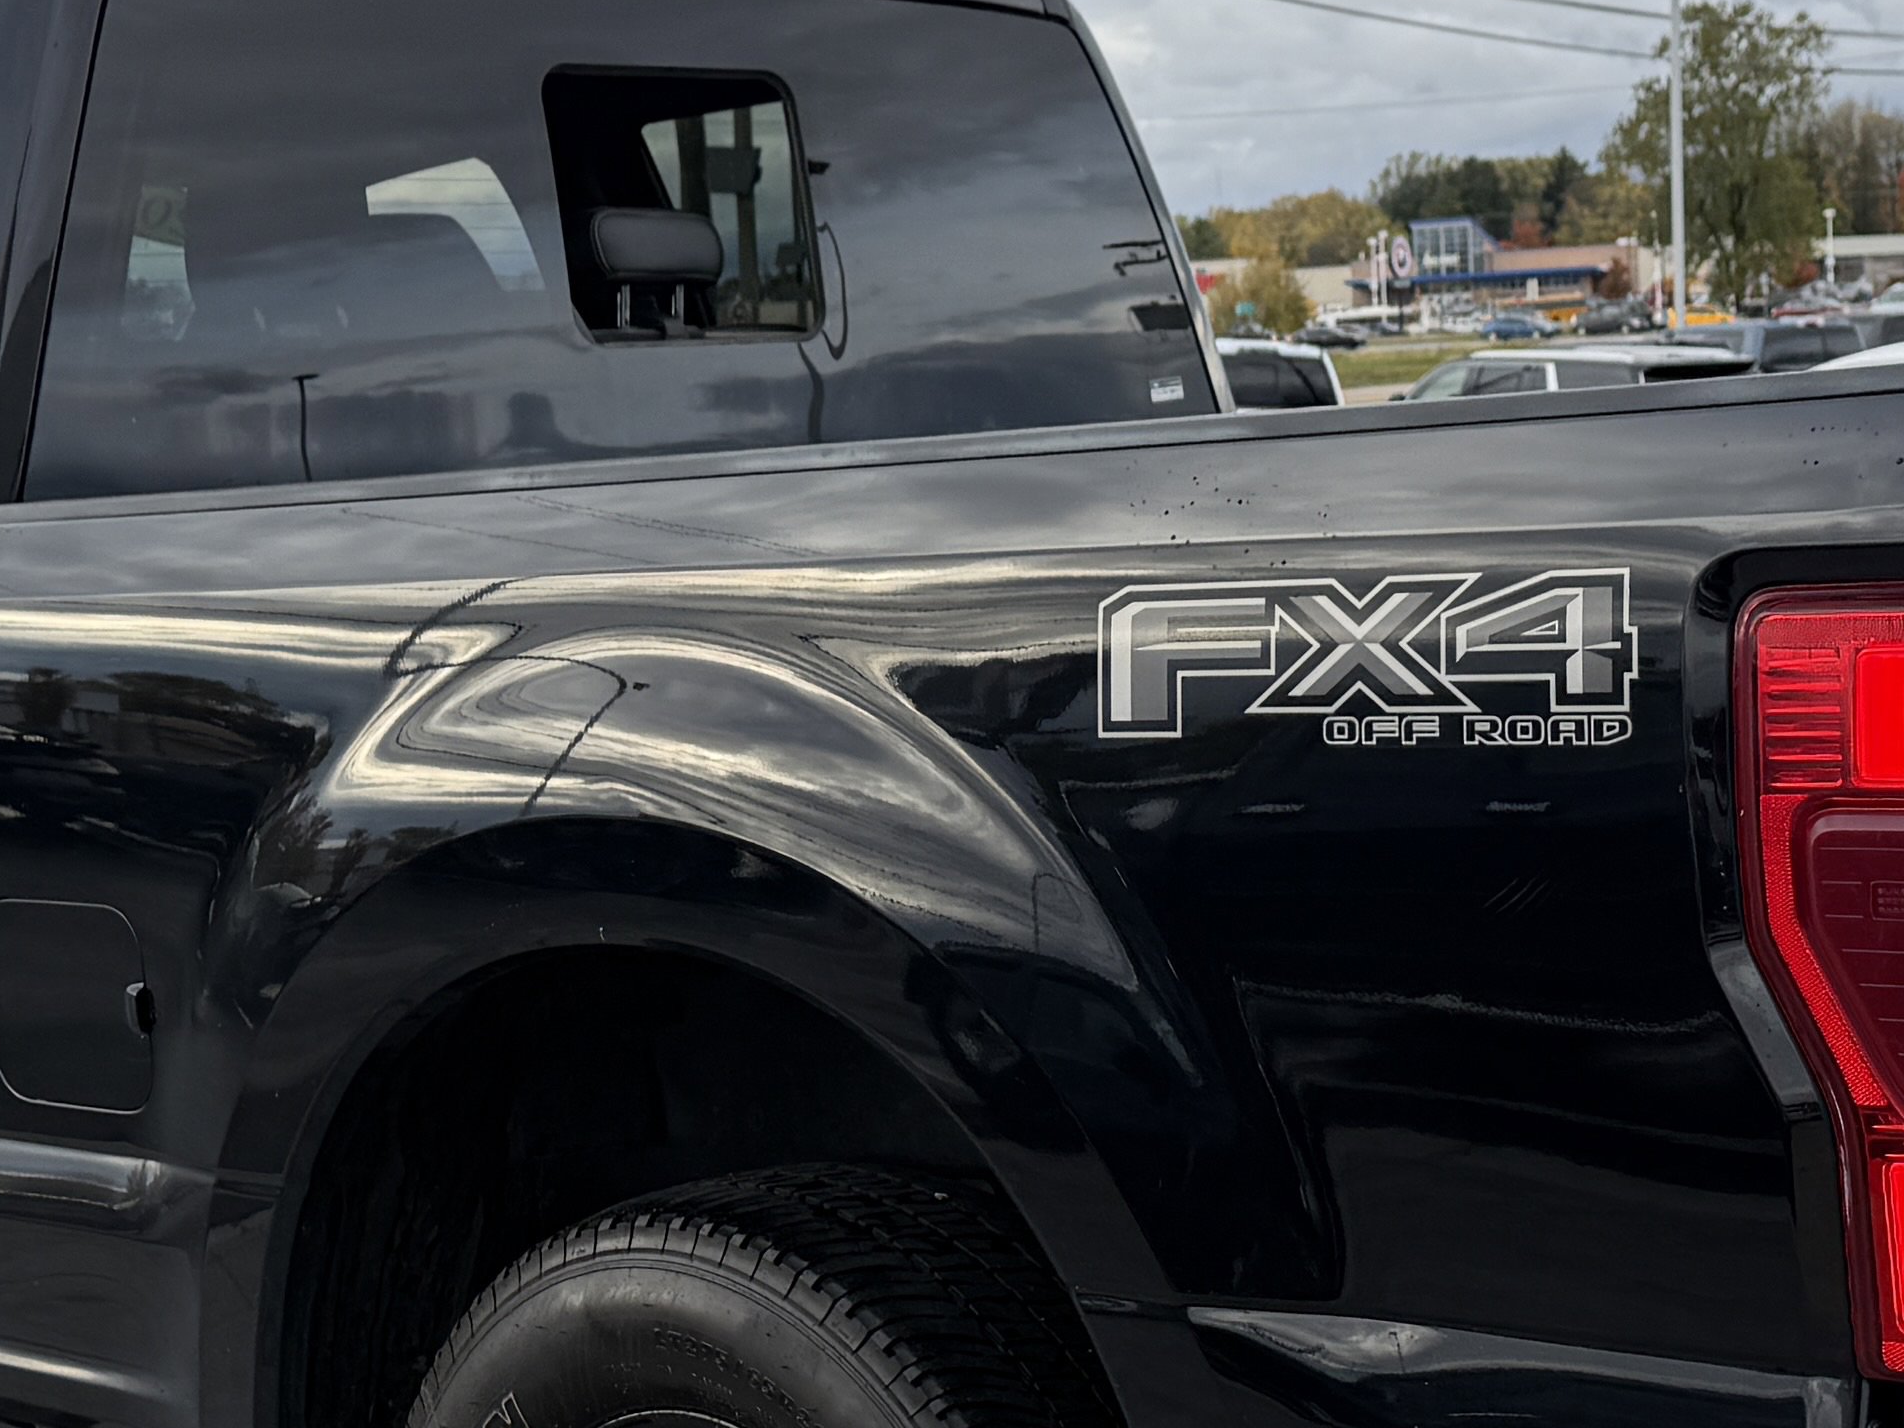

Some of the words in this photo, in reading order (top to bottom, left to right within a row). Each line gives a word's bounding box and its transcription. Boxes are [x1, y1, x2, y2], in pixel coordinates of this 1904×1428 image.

[1097, 567, 1639, 739] FX4
[1322, 714, 1441, 745] OFF
[1462, 714, 1633, 746] ROAD
